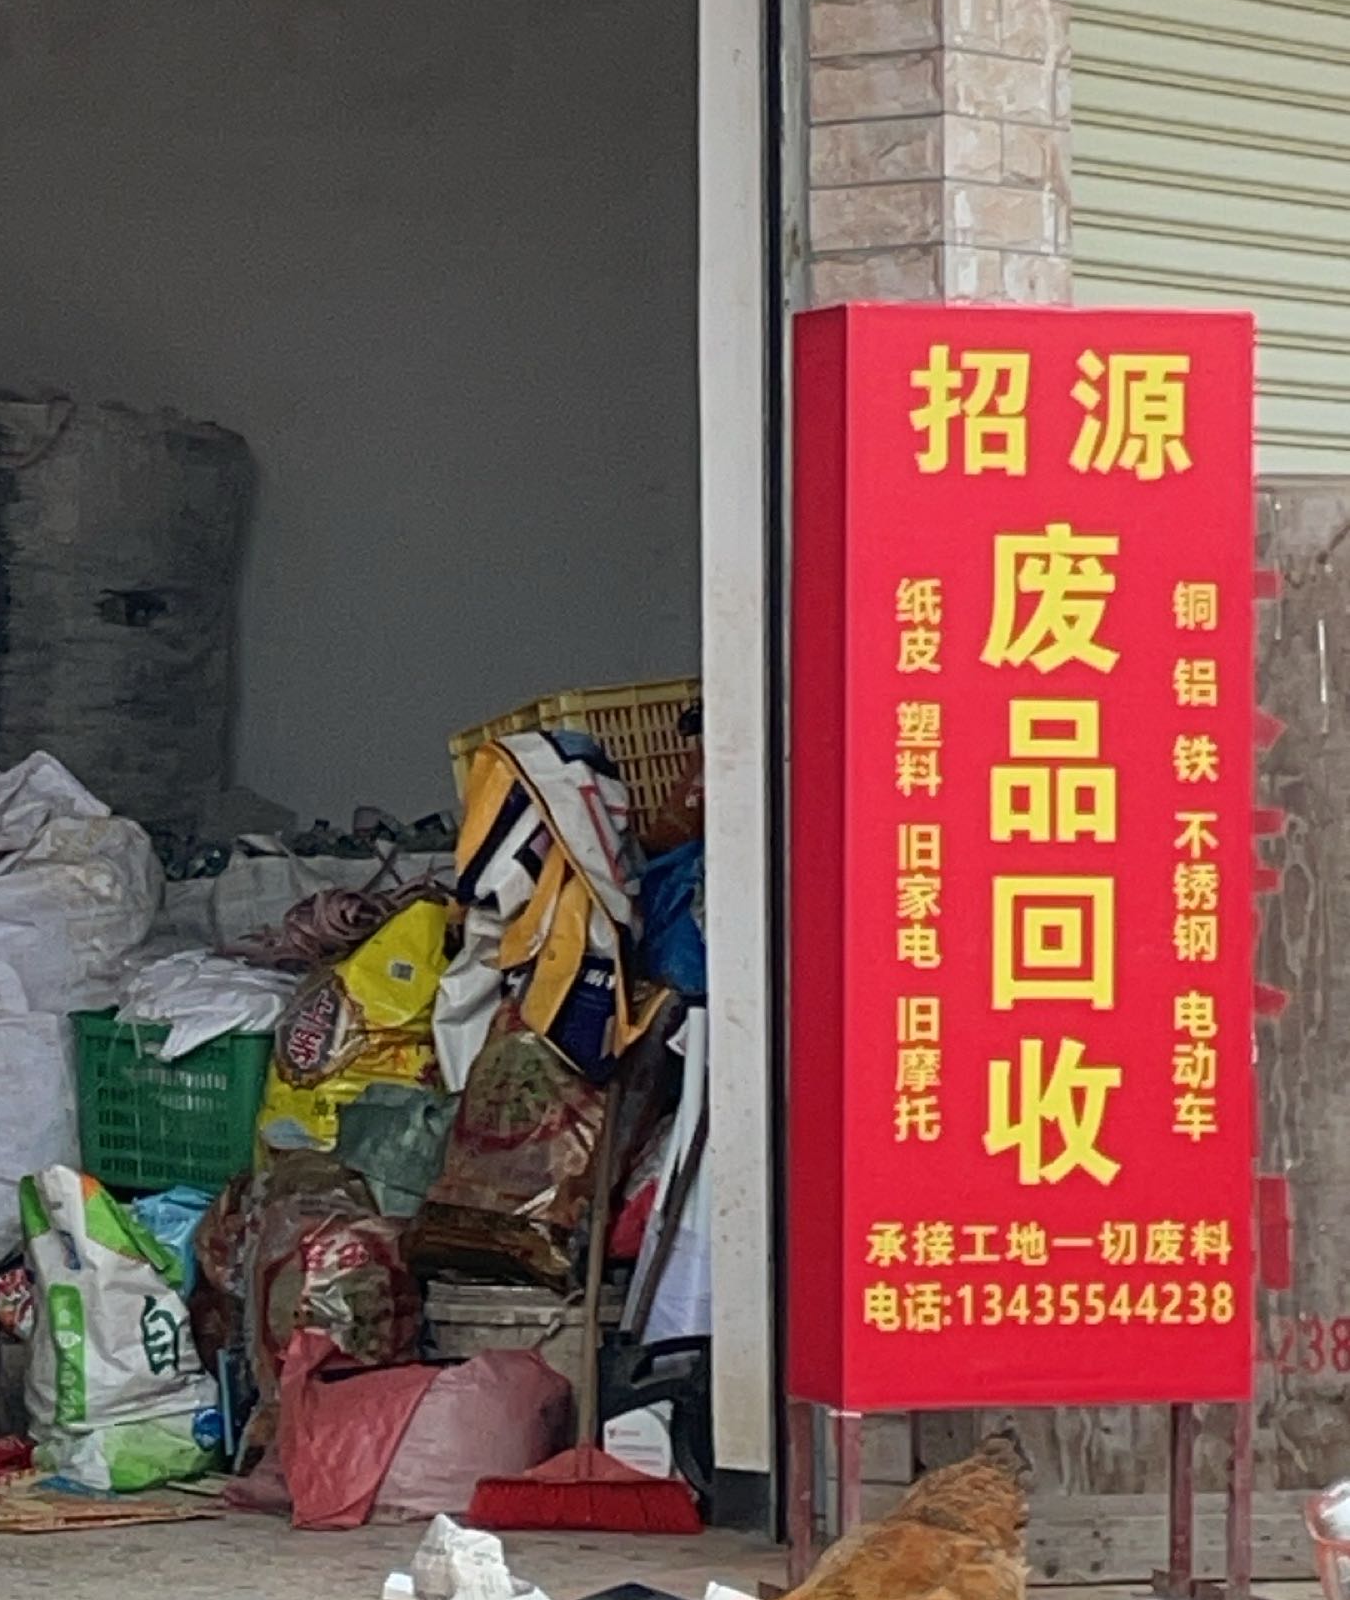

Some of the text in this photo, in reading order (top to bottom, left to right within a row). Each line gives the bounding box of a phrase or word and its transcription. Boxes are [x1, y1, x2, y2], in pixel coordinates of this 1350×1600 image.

[909, 344, 1193, 481] 招源
[893, 577, 943, 1143] 纸皮 塑料 旧家电 旧摩托
[979, 522, 1122, 1187] 废品回收
[1171, 580, 1219, 1142] 铜 铝 铁 不锈钢 电动车
[865, 1219, 1233, 1268] 承接工地一切废料
